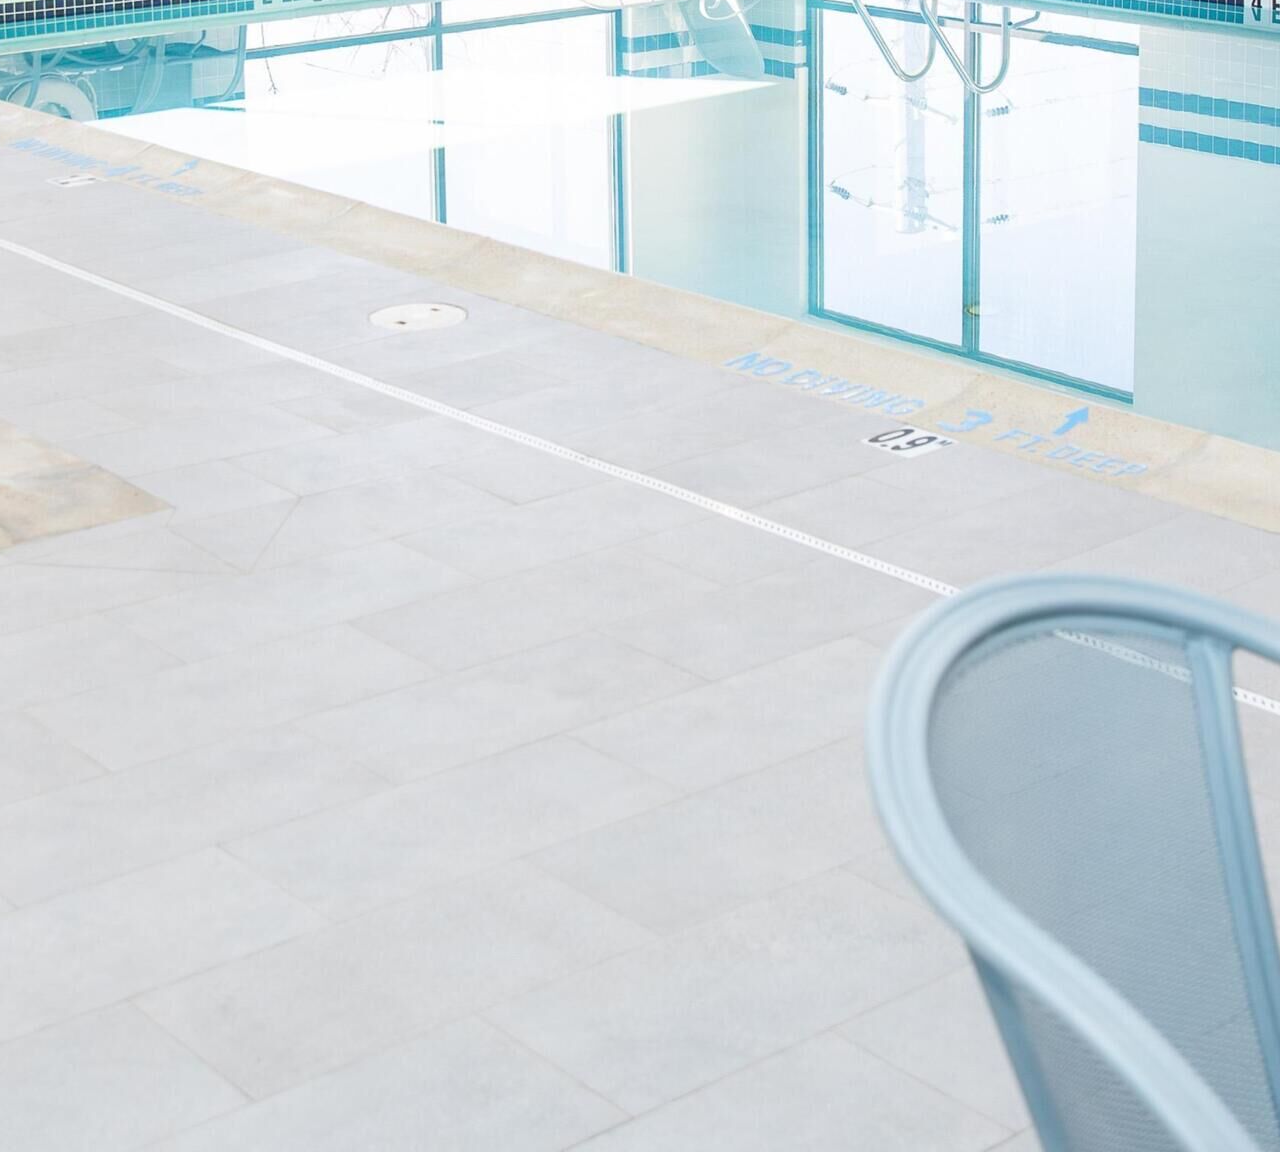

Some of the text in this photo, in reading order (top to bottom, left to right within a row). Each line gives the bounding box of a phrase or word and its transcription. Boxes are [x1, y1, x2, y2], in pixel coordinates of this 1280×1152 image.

[724, 352, 793, 377] NO
[782, 367, 926, 416] DIVING
[936, 408, 993, 432] 3
[1045, 444, 1148, 477] DEEP
